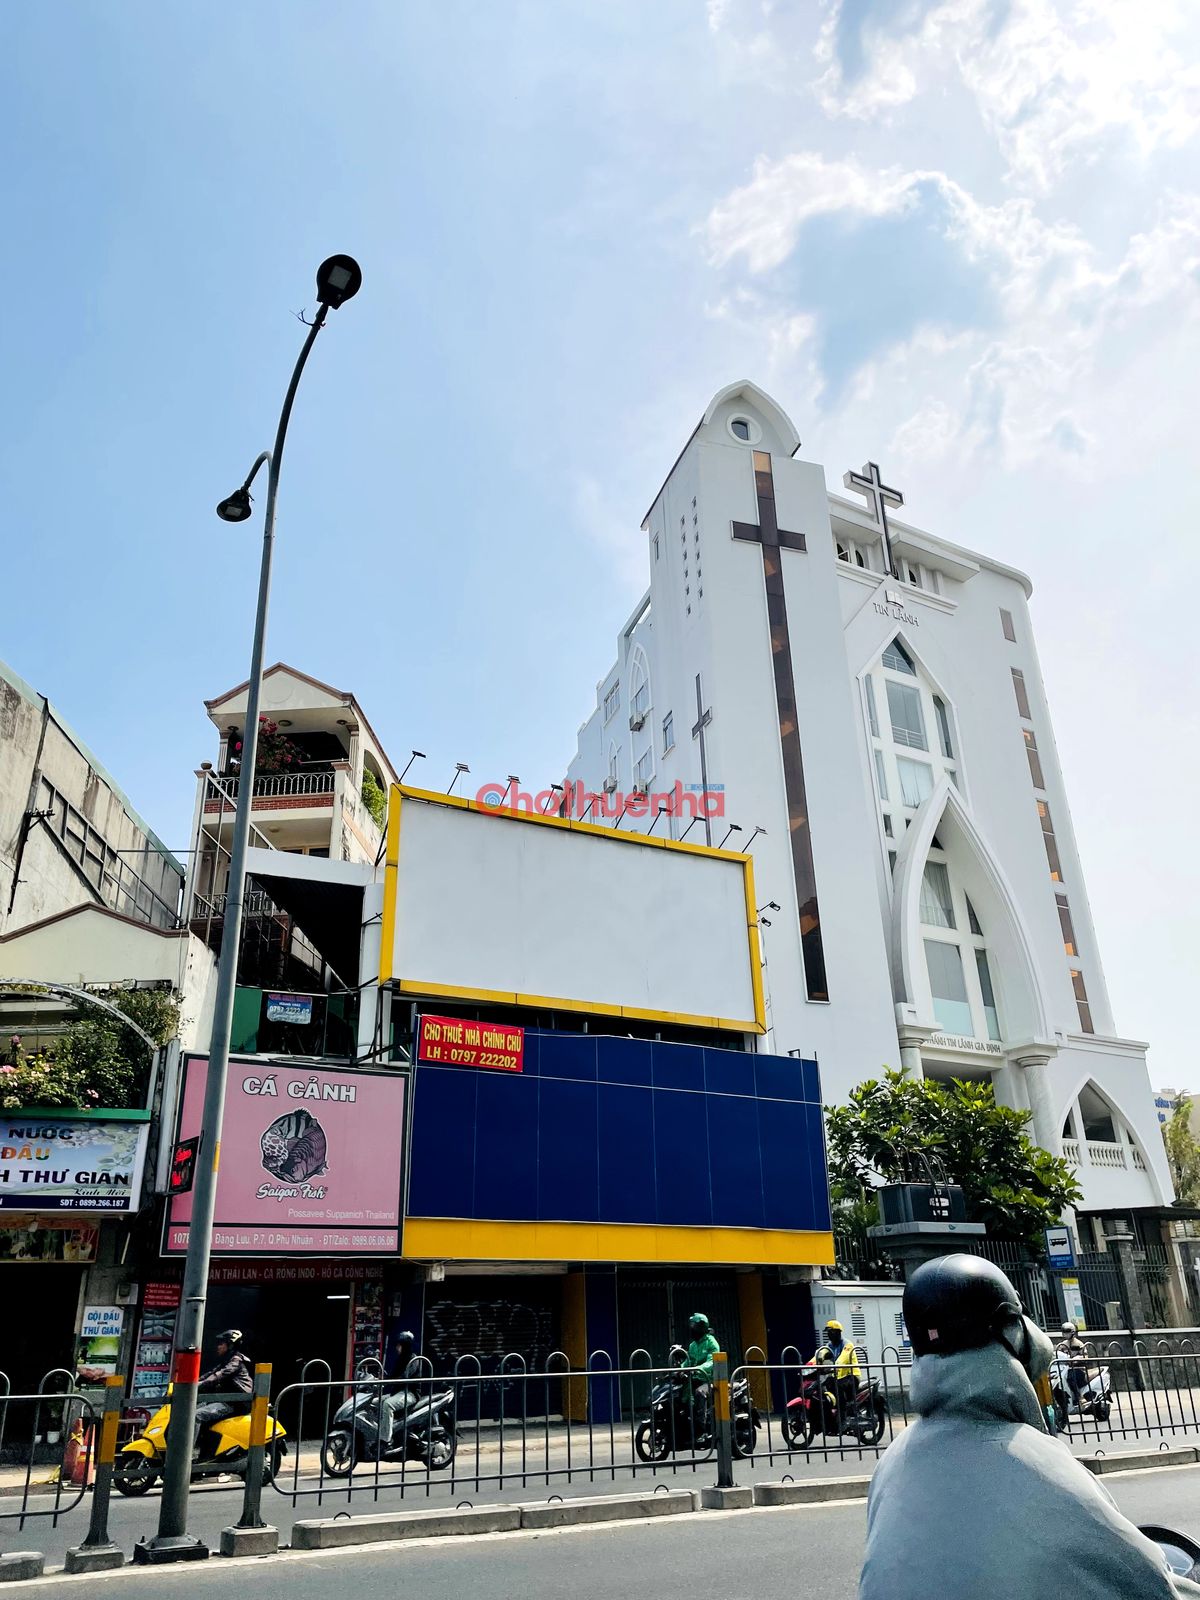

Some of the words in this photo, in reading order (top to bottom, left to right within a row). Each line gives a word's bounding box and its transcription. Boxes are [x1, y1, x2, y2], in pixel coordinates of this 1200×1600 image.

[424, 1023, 441, 1041] CHO
[442, 1024, 463, 1044] THUÊ
[465, 1026, 481, 1047] NHÀ
[483, 1028, 506, 1050] CHÍNH
[507, 1030, 522, 1053] CHỦ
[426, 1045, 441, 1059] LH
[450, 1048, 477, 1064] 0797
[479, 1052, 517, 1069] 222202
[242, 1074, 278, 1097] CÁ
[286, 1076, 357, 1103] CẢNH
[8, 1125, 75, 1141] NƯỚC
[19, 1168, 70, 1184] THƯ
[74, 1168, 130, 1185] GIÃN
[256, 1182, 299, 1202] Saigon
[366, 1210, 395, 1220] Thailand
